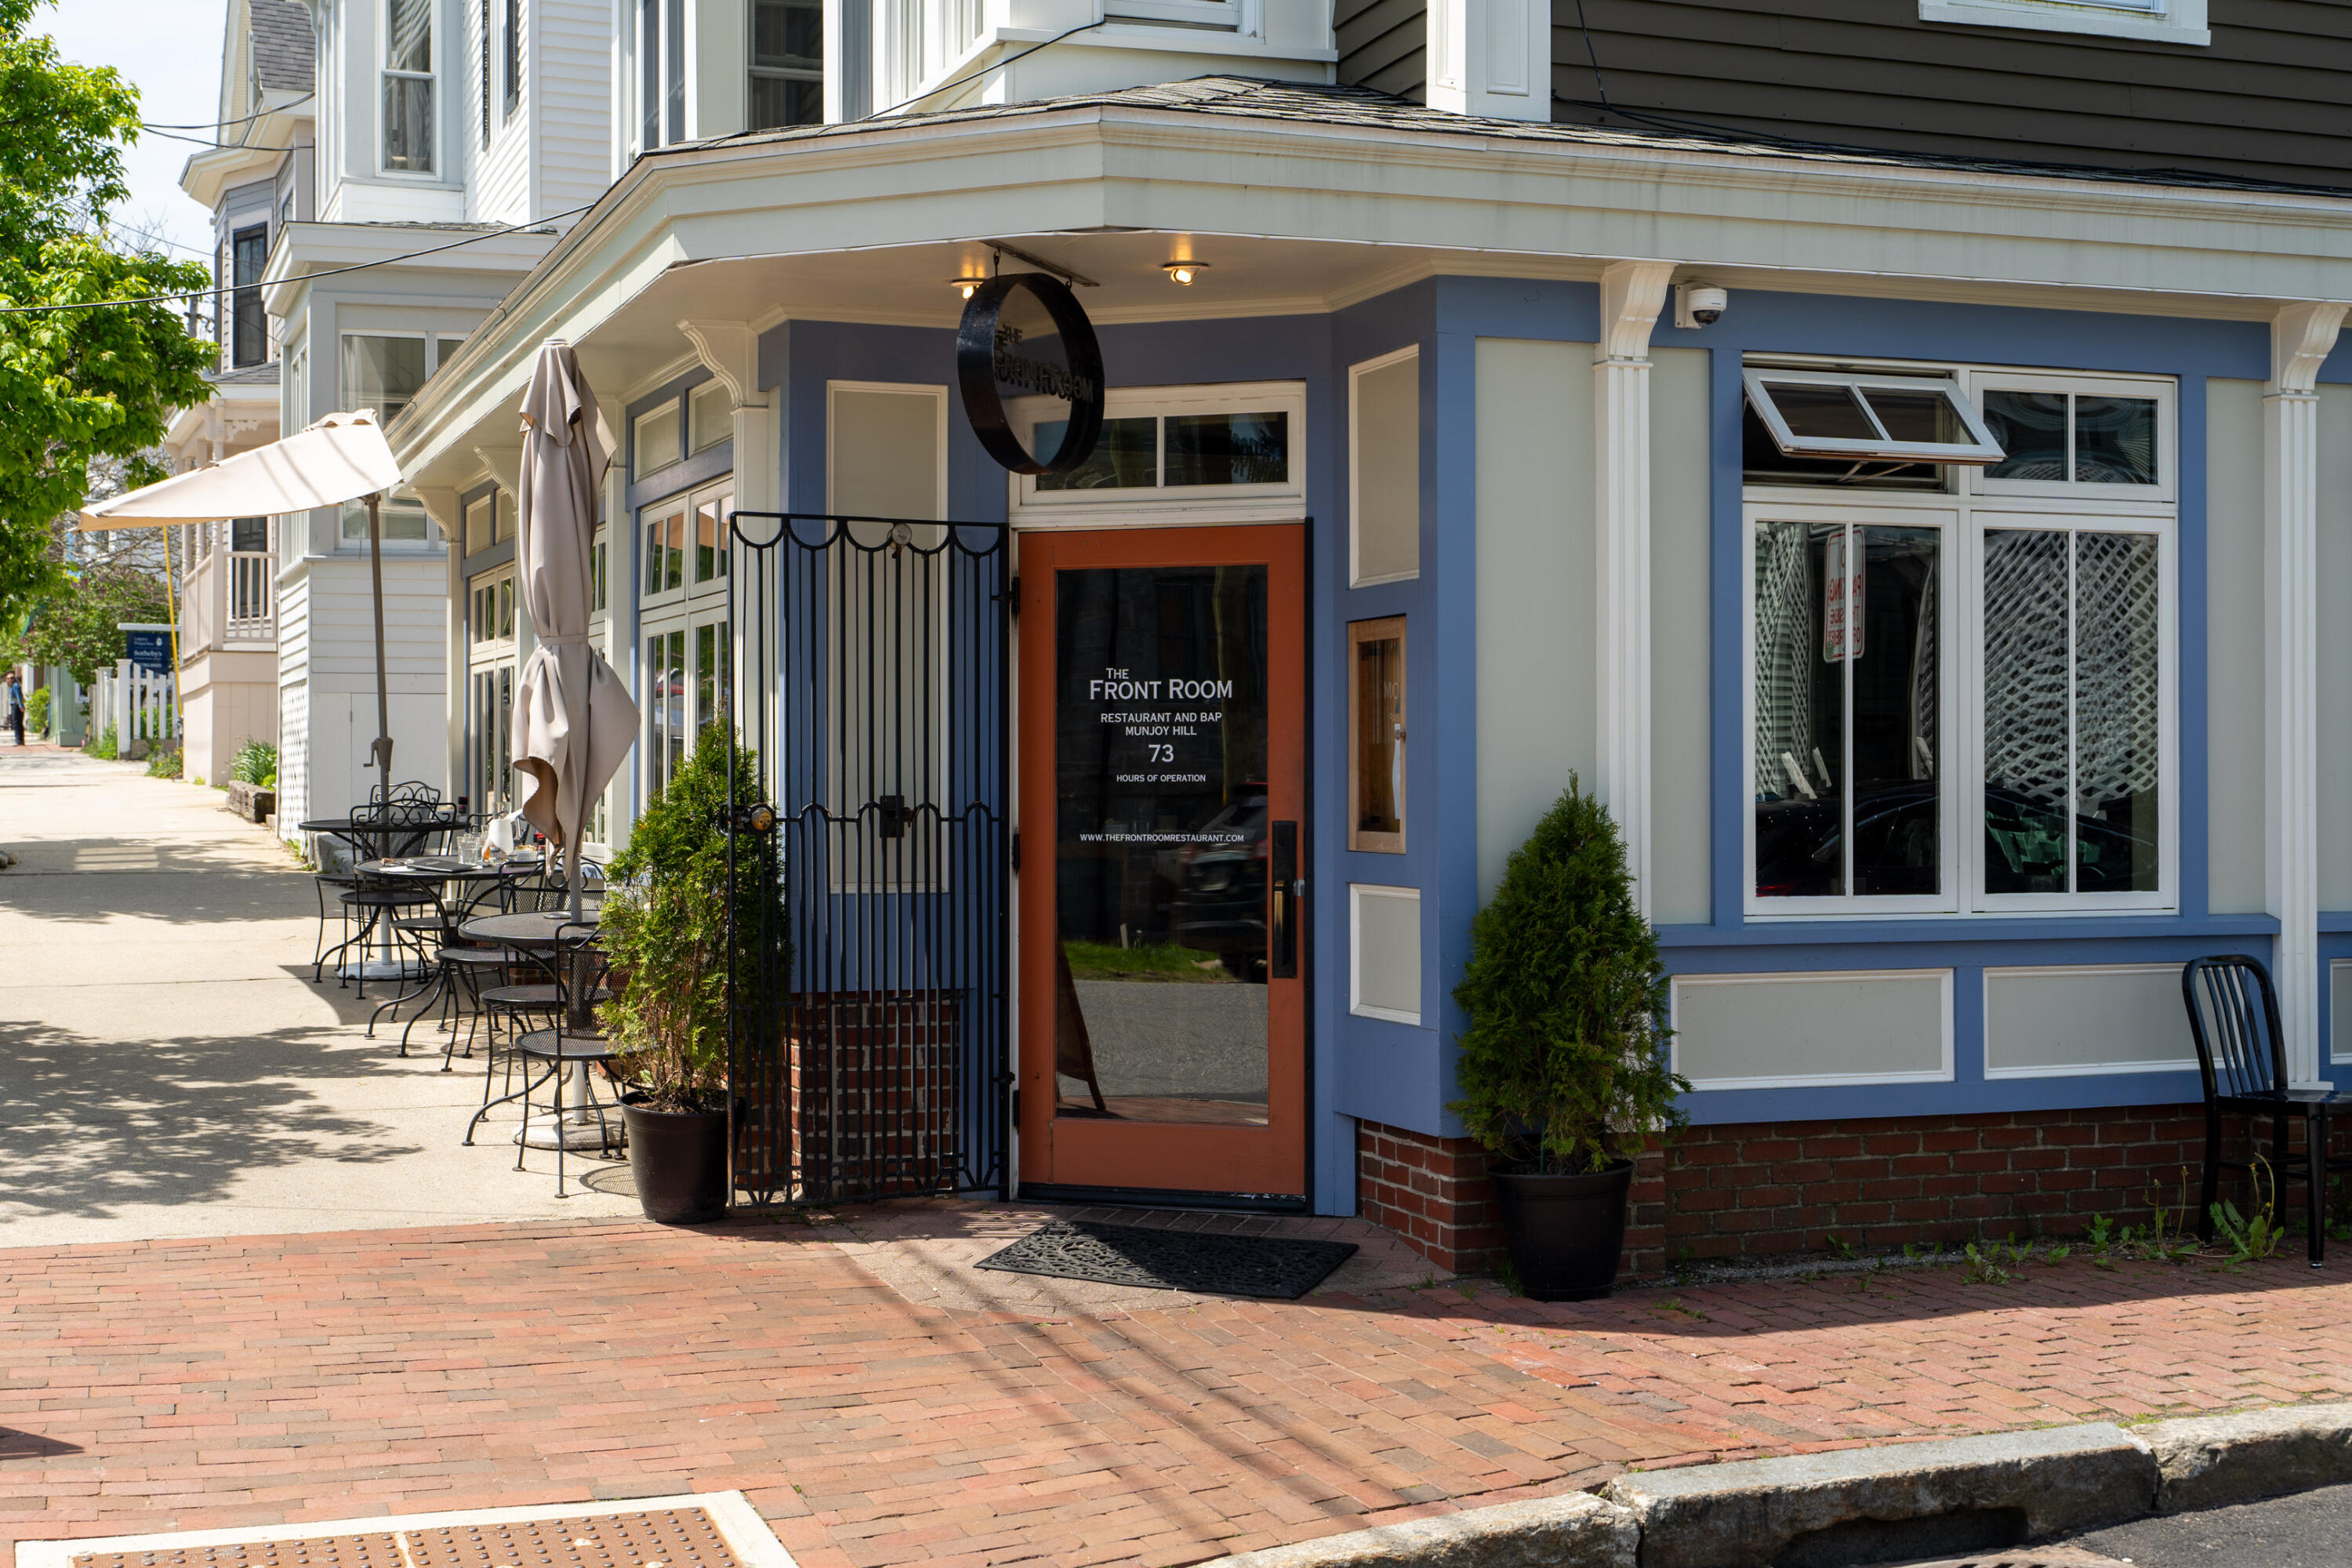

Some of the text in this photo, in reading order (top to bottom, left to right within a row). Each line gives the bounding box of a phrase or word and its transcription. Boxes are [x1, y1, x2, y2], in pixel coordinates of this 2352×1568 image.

[133, 650, 162, 659] Sotheby's
[1106, 668, 1129, 679] THE
[1090, 678, 1233, 700] FRONT ROOM
[1100, 713, 1172, 723] RESTAURANT
[1174, 713, 1198, 722] AND
[1125, 726, 1198, 736] MUNJOY HILL
[1148, 744, 1174, 763] 73
[1160, 774, 1207, 782] OPERATION
[1080, 833, 1245, 843] WWW.THEFRONTROOMRESTAURANT.COM
